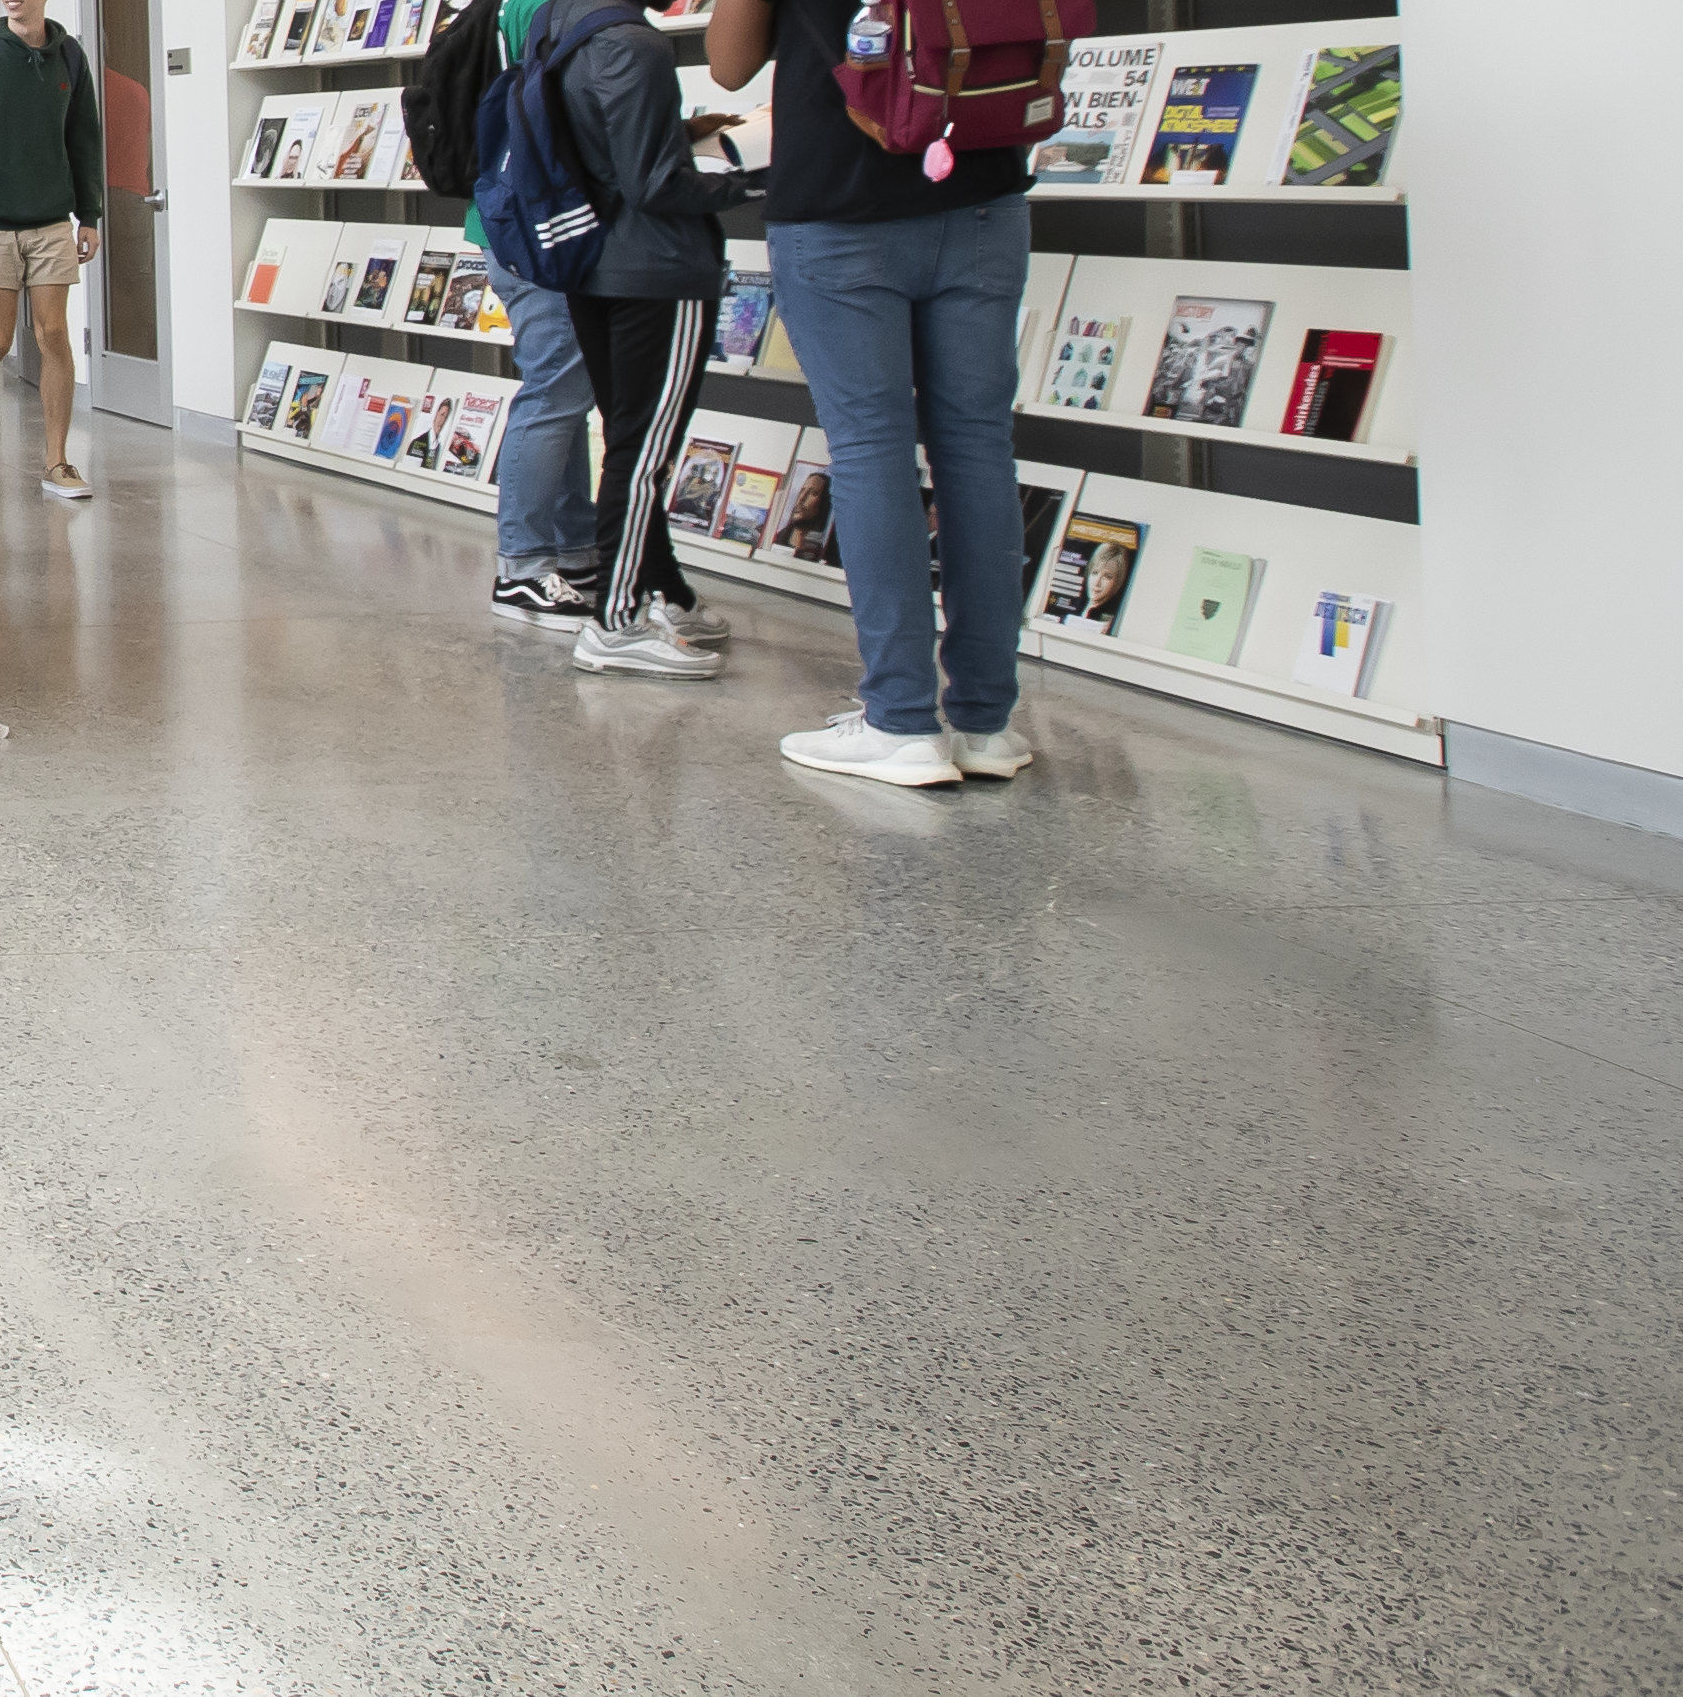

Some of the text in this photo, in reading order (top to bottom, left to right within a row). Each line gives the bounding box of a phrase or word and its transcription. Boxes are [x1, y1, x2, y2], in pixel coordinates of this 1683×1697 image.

[1069, 47, 1156, 68] VOLUME
[1123, 70, 1150, 87] 54
[1065, 91, 1084, 108] N
[1087, 90, 1143, 109] BIEN-
[1294, 364, 1321, 432] wirkendes
